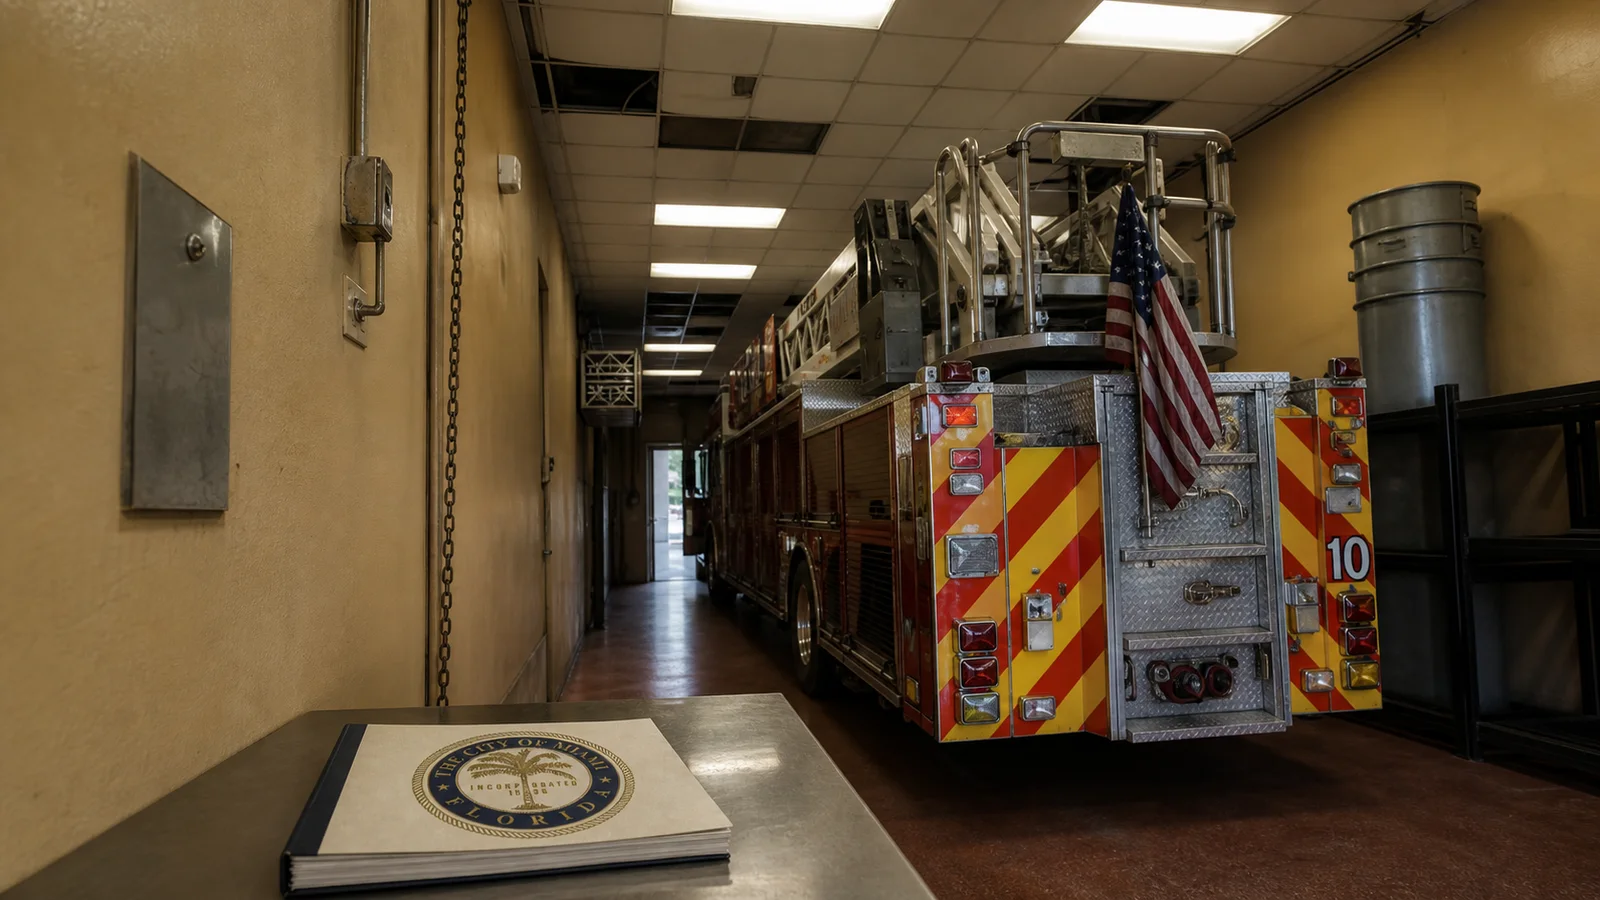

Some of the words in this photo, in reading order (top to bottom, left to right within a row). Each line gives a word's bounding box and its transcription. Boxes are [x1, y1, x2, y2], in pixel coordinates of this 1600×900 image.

[1326, 535, 1371, 581] 10
[435, 755, 464, 778] THE
[463, 740, 508, 757] CITY
[517, 738, 548, 749] OF
[553, 741, 609, 771] MIAMI
[445, 790, 611, 826] FLORIDA
